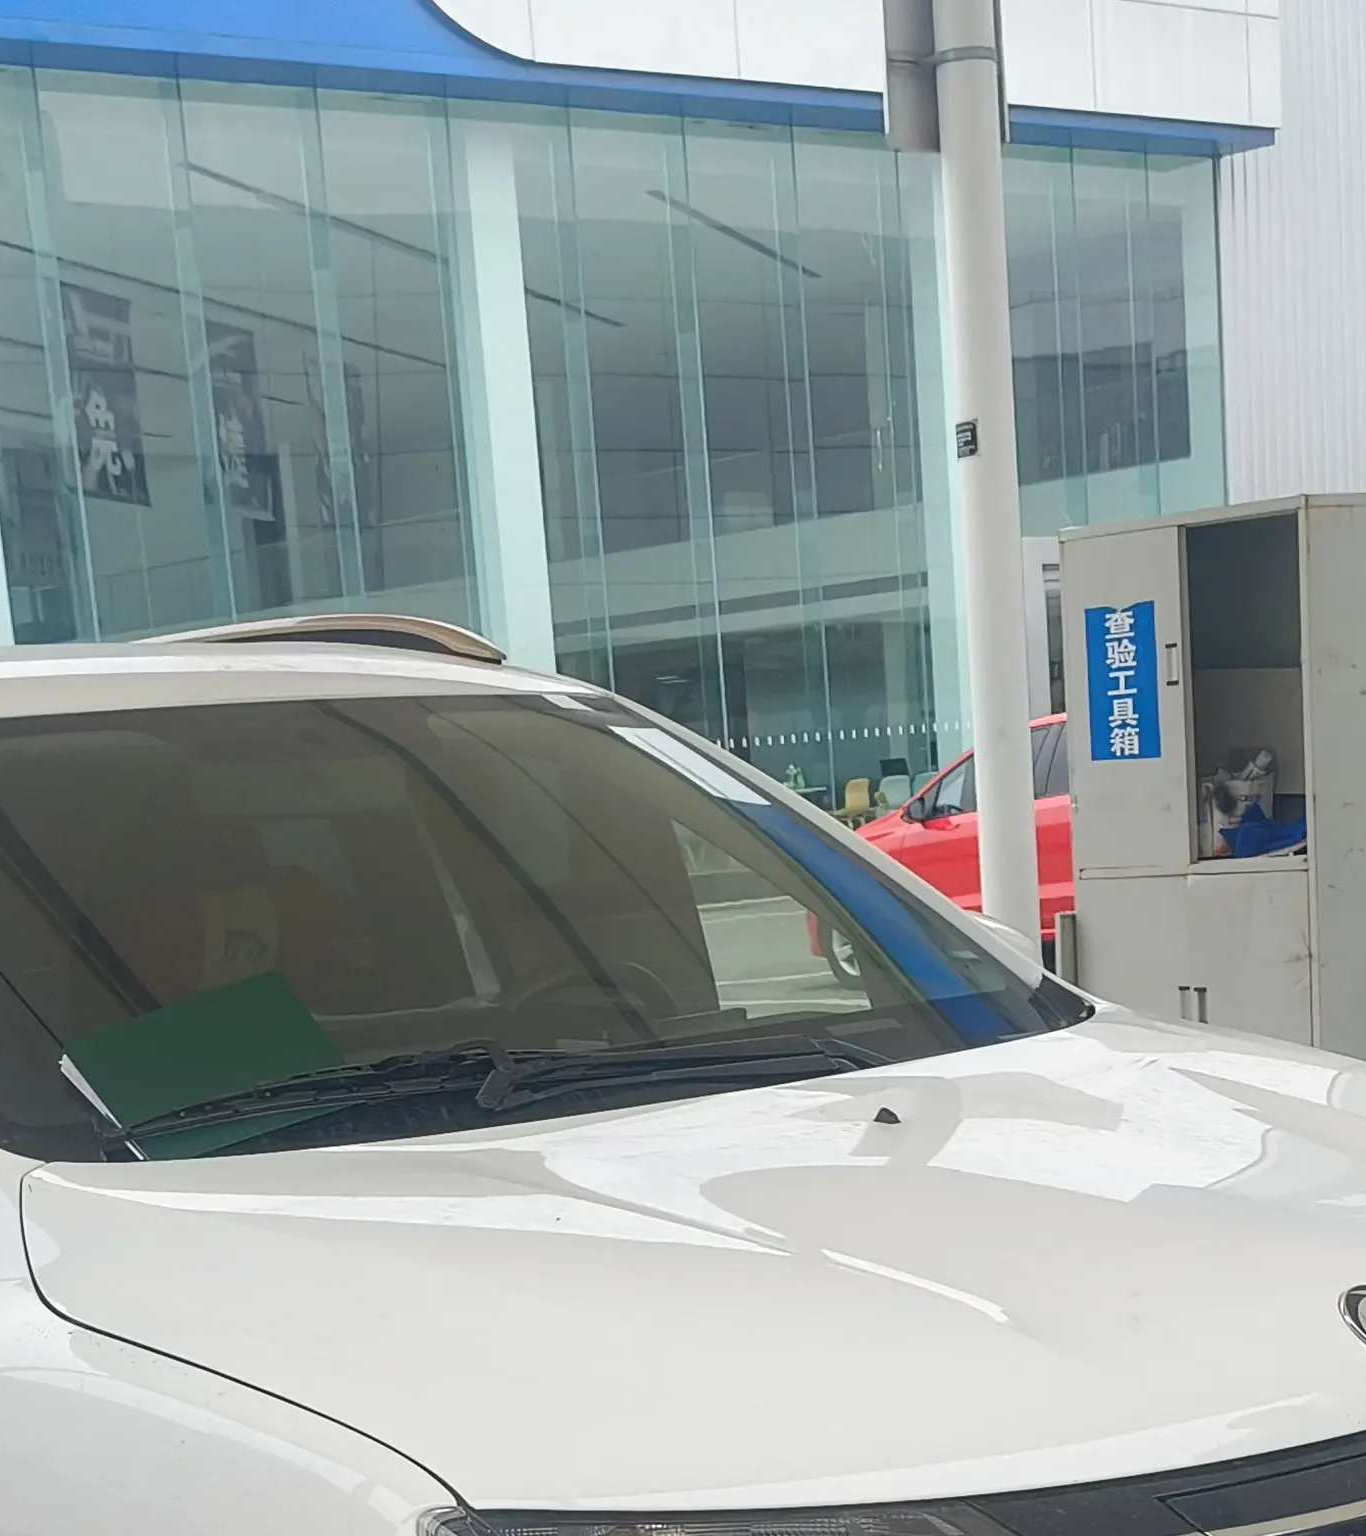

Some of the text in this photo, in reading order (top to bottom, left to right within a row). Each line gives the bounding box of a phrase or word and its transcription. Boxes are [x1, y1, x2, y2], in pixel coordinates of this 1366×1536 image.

[1103, 608, 1140, 757] 查验工具箱
